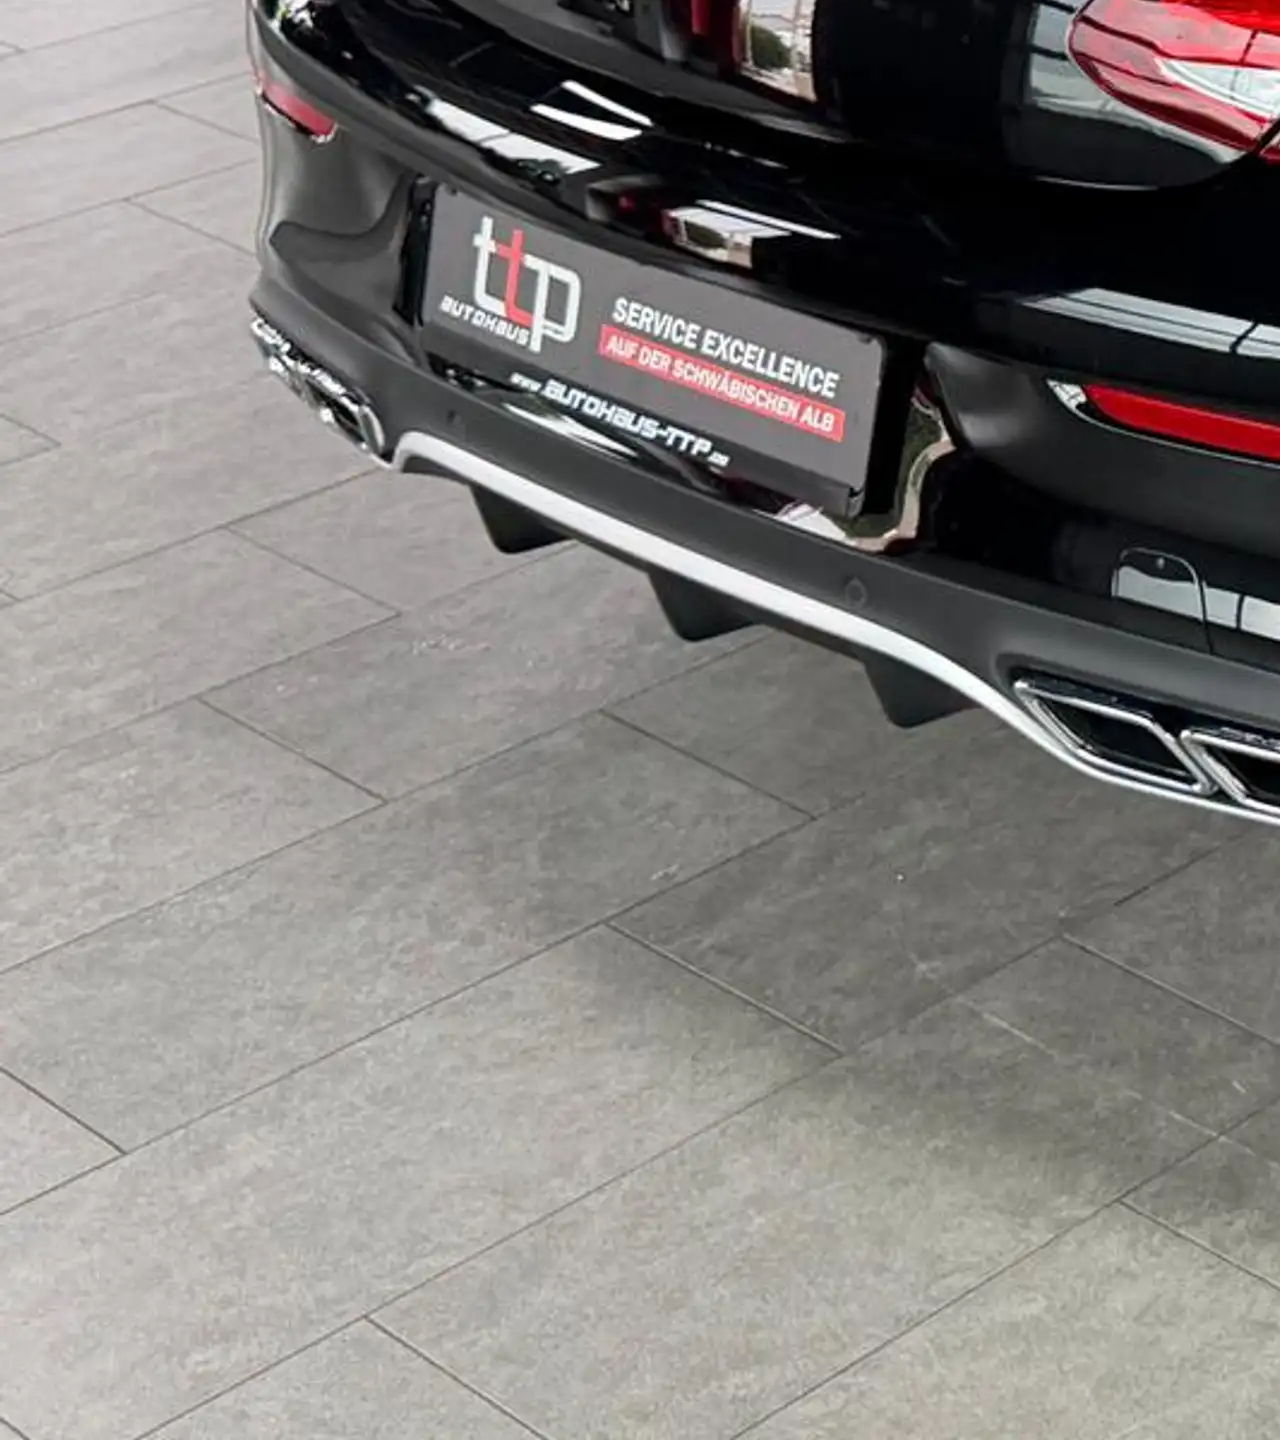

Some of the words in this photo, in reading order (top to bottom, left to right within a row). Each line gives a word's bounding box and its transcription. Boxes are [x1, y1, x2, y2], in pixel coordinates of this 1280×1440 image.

[440, 295, 530, 346] AUTOHAUS
[472, 216, 581, 352] ttp
[606, 335, 639, 359] AUF
[638, 347, 672, 371] DER
[672, 361, 801, 419] SCHWÄBISCHEN
[800, 406, 836, 433] ALB
[612, 297, 701, 349] SERVICE
[701, 328, 840, 398] EXCELLENCE
